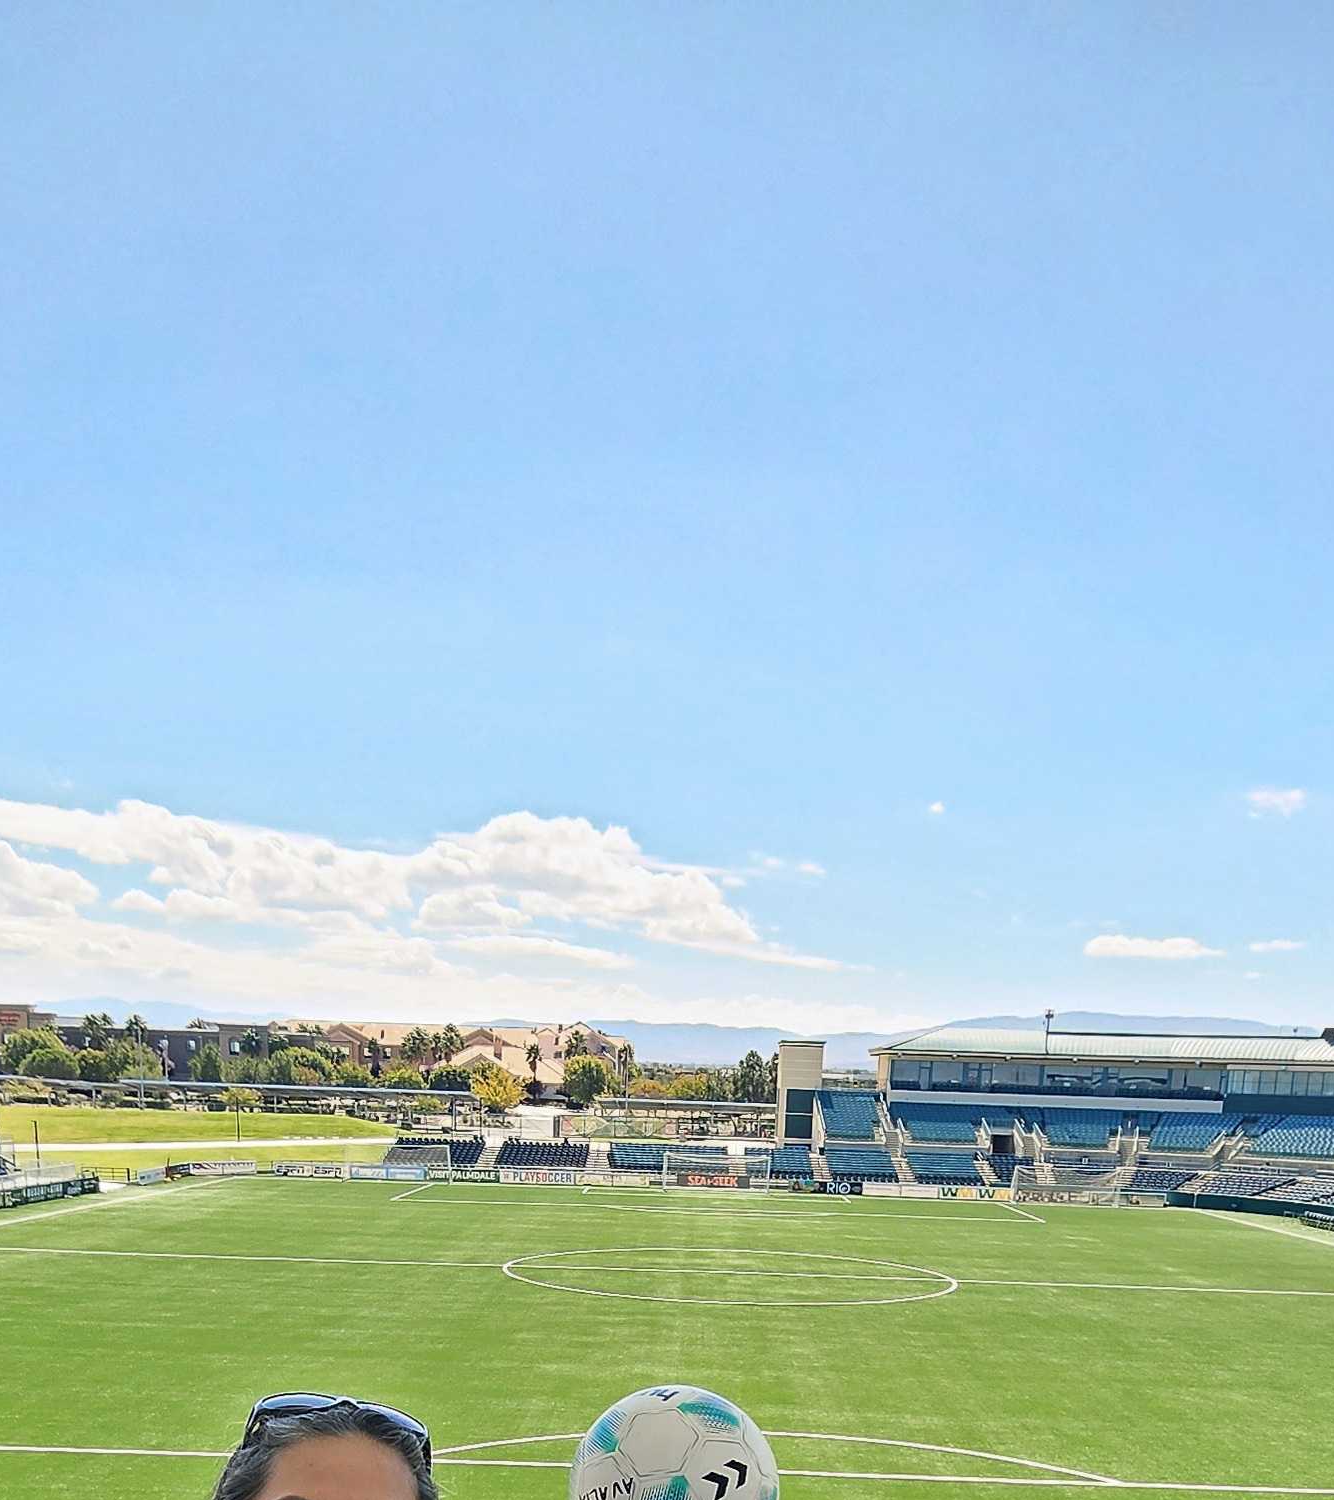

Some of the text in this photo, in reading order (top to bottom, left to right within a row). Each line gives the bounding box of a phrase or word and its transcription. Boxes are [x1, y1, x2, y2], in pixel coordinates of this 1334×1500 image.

[314, 1166, 342, 1175] ESPN
[428, 1169, 450, 1180] VISIT
[451, 1170, 497, 1181] PALMDALE
[826, 1182, 851, 1194] RIO
